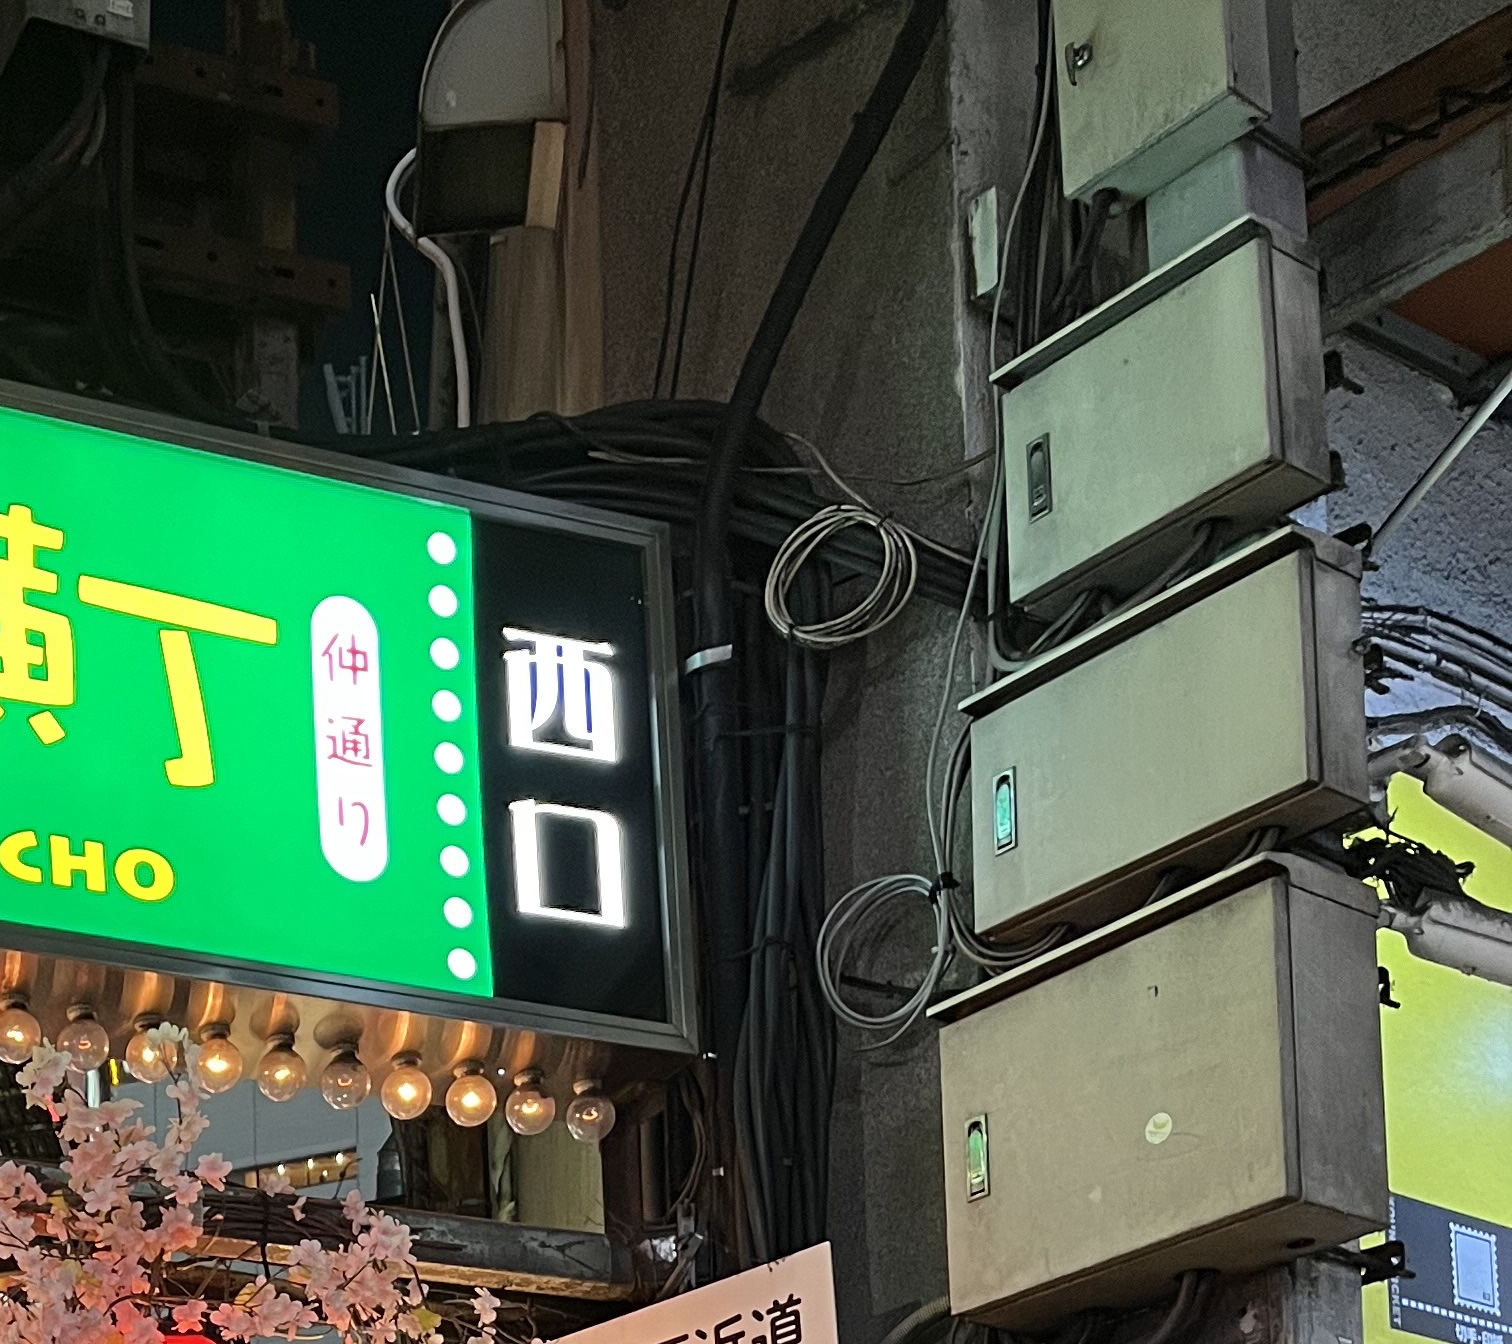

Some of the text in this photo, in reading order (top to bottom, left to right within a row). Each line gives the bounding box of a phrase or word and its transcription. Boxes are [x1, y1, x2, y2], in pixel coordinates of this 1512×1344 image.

[320, 631, 374, 848] 仲通り
[501, 625, 627, 929] 西口
